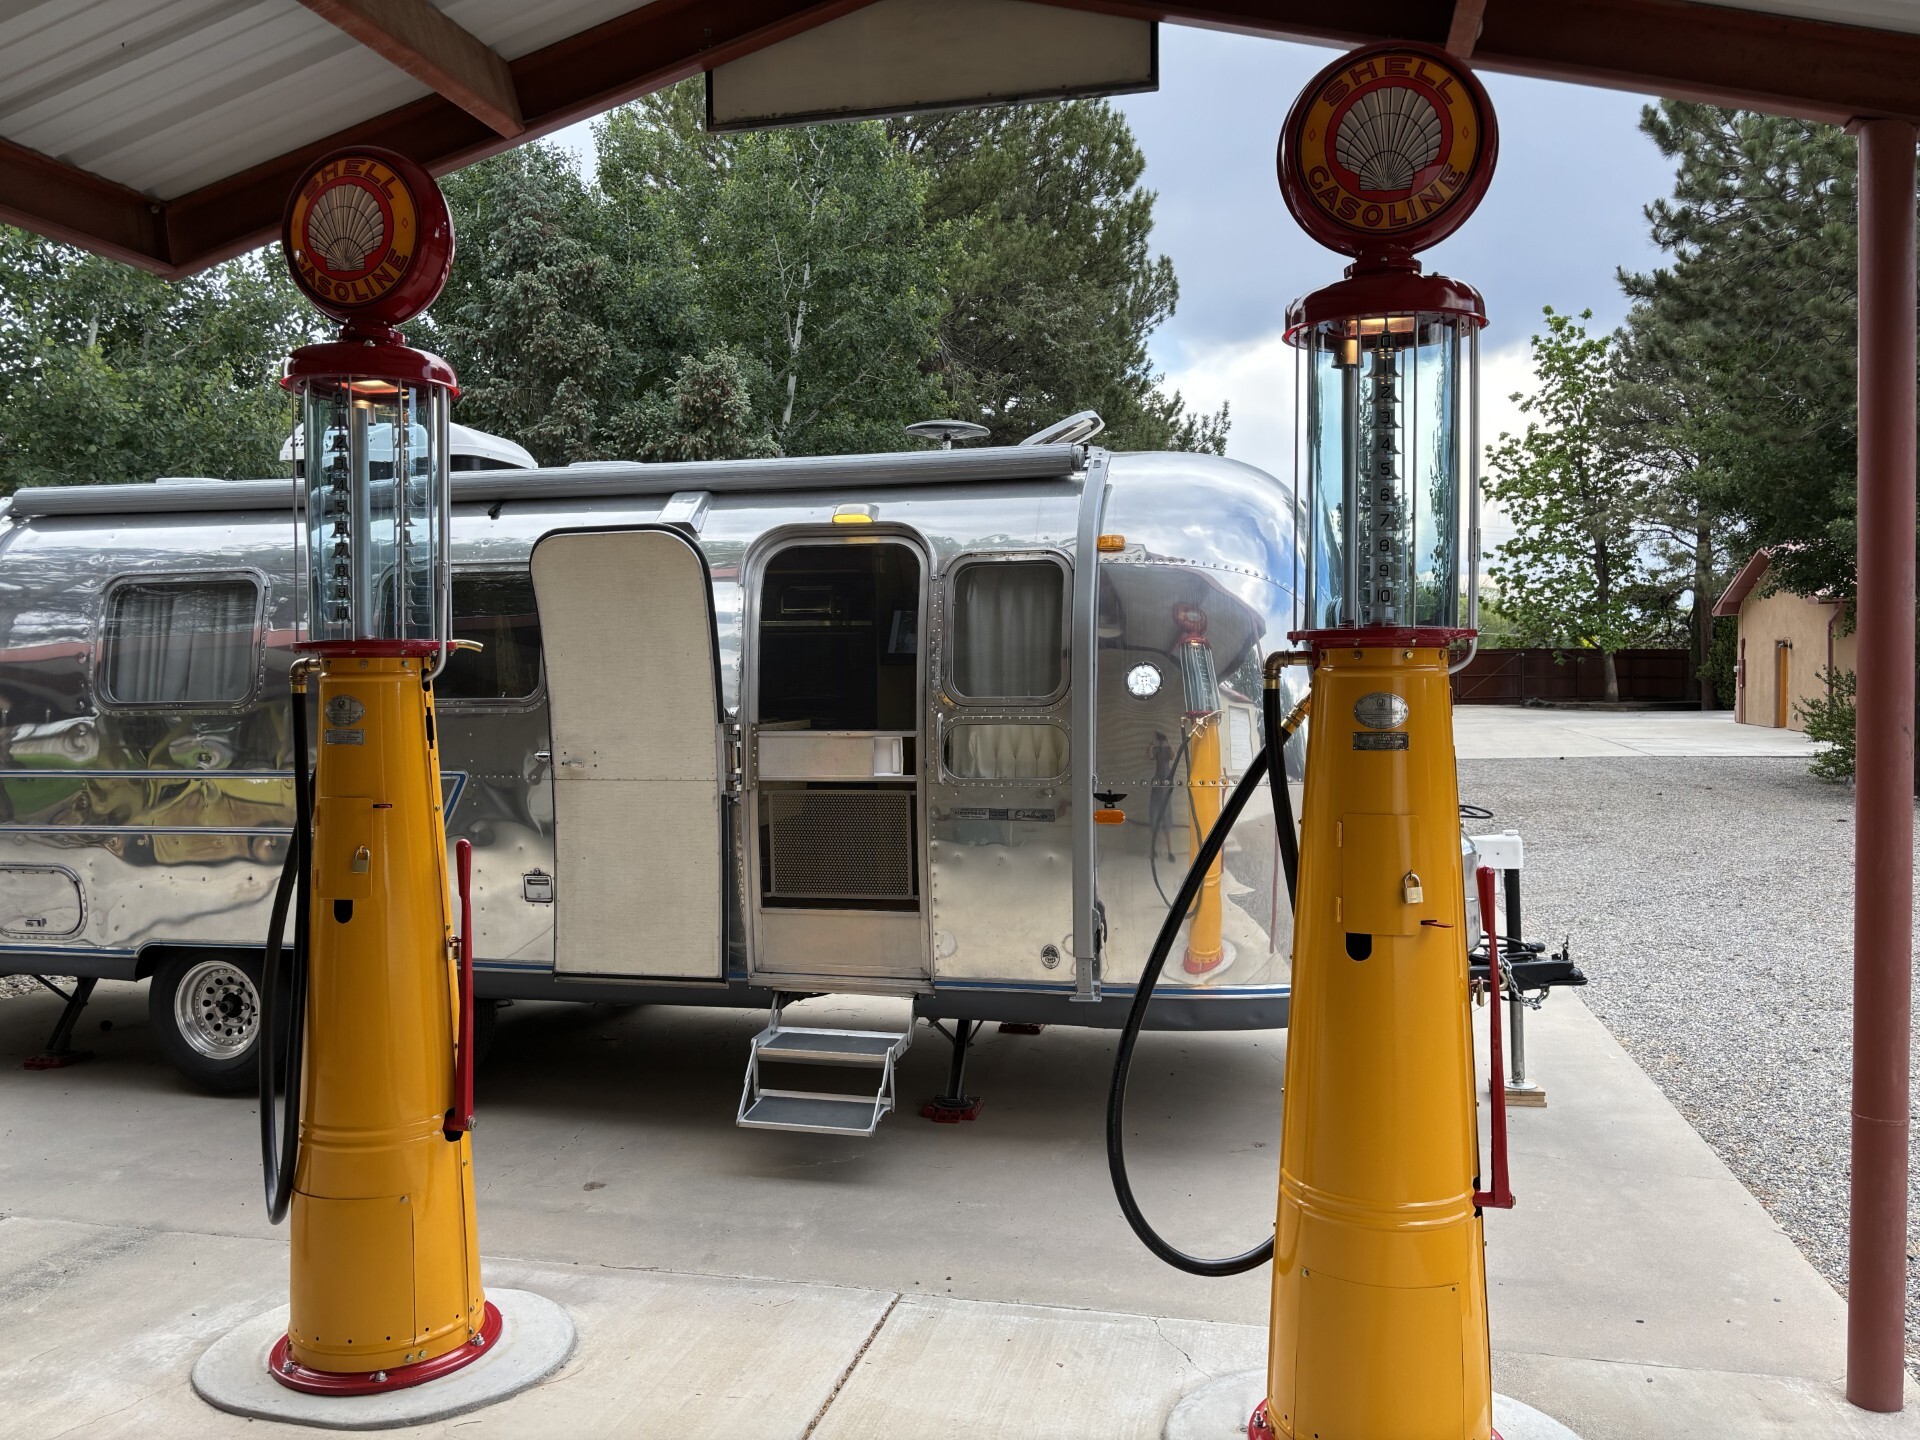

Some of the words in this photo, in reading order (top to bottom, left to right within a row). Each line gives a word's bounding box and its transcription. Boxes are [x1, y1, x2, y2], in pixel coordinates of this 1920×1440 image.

[1322, 56, 1454, 107] SHELL
[303, 159, 397, 201] SHELL
[1308, 163, 1465, 227] GASOLINE
[297, 248, 409, 302] GASOLINE
[1381, 334, 1391, 348] 0
[1381, 385, 1391, 399] 2
[335, 393, 343, 405] 0
[1380, 411, 1391, 424] 3
[336, 437, 344, 449] 2
[1380, 437, 1391, 450] 4
[336, 458, 344, 470] 3
[1380, 462, 1391, 476] 5
[336, 480, 345, 491] 4
[1380, 488, 1390, 501] 6
[336, 501, 345, 512] 5
[1380, 513, 1390, 527] 7
[337, 522, 345, 534] 6
[337, 544, 345, 554] 7
[1379, 539, 1390, 552] 8
[338, 565, 346, 577] 8
[1379, 564, 1389, 577] 9
[338, 586, 346, 598] 9
[1377, 589, 1391, 603] 10
[336, 608, 347, 620] 10
